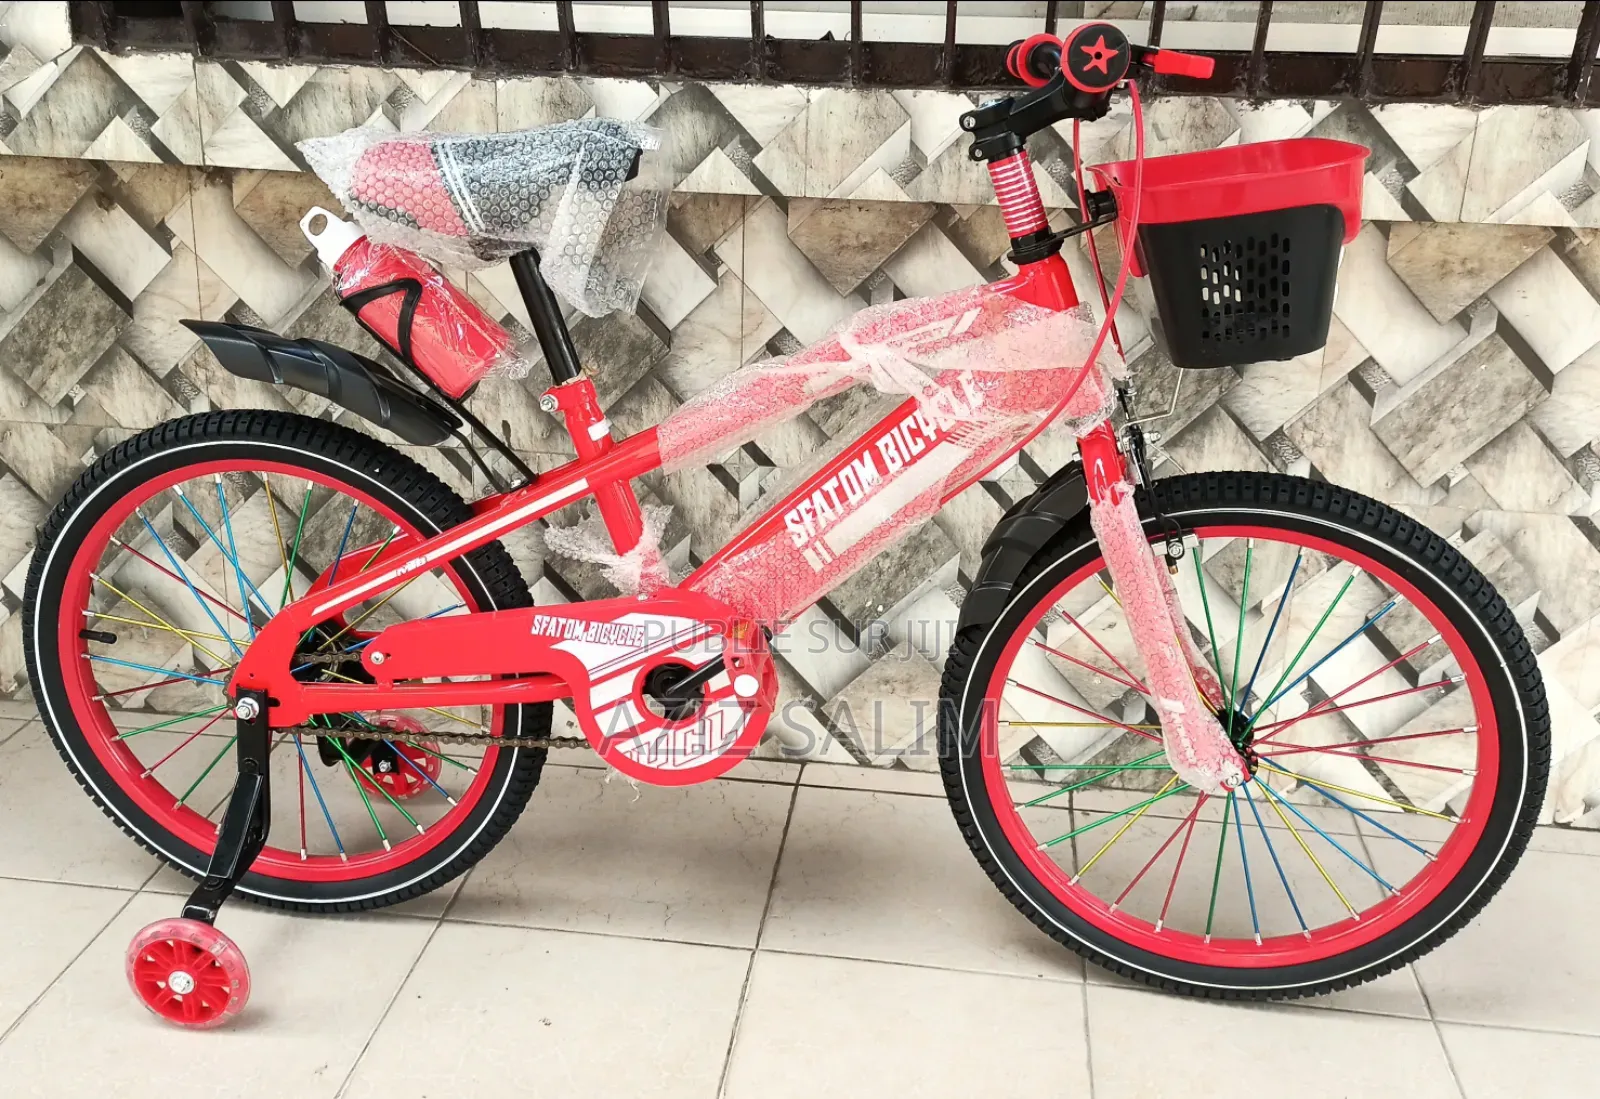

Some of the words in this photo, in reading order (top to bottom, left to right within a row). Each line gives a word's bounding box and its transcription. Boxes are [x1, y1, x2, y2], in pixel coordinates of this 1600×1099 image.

[784, 449, 882, 548] SFATOM
[531, 614, 586, 642] SFATOM
[586, 621, 645, 648] BICYCLE
